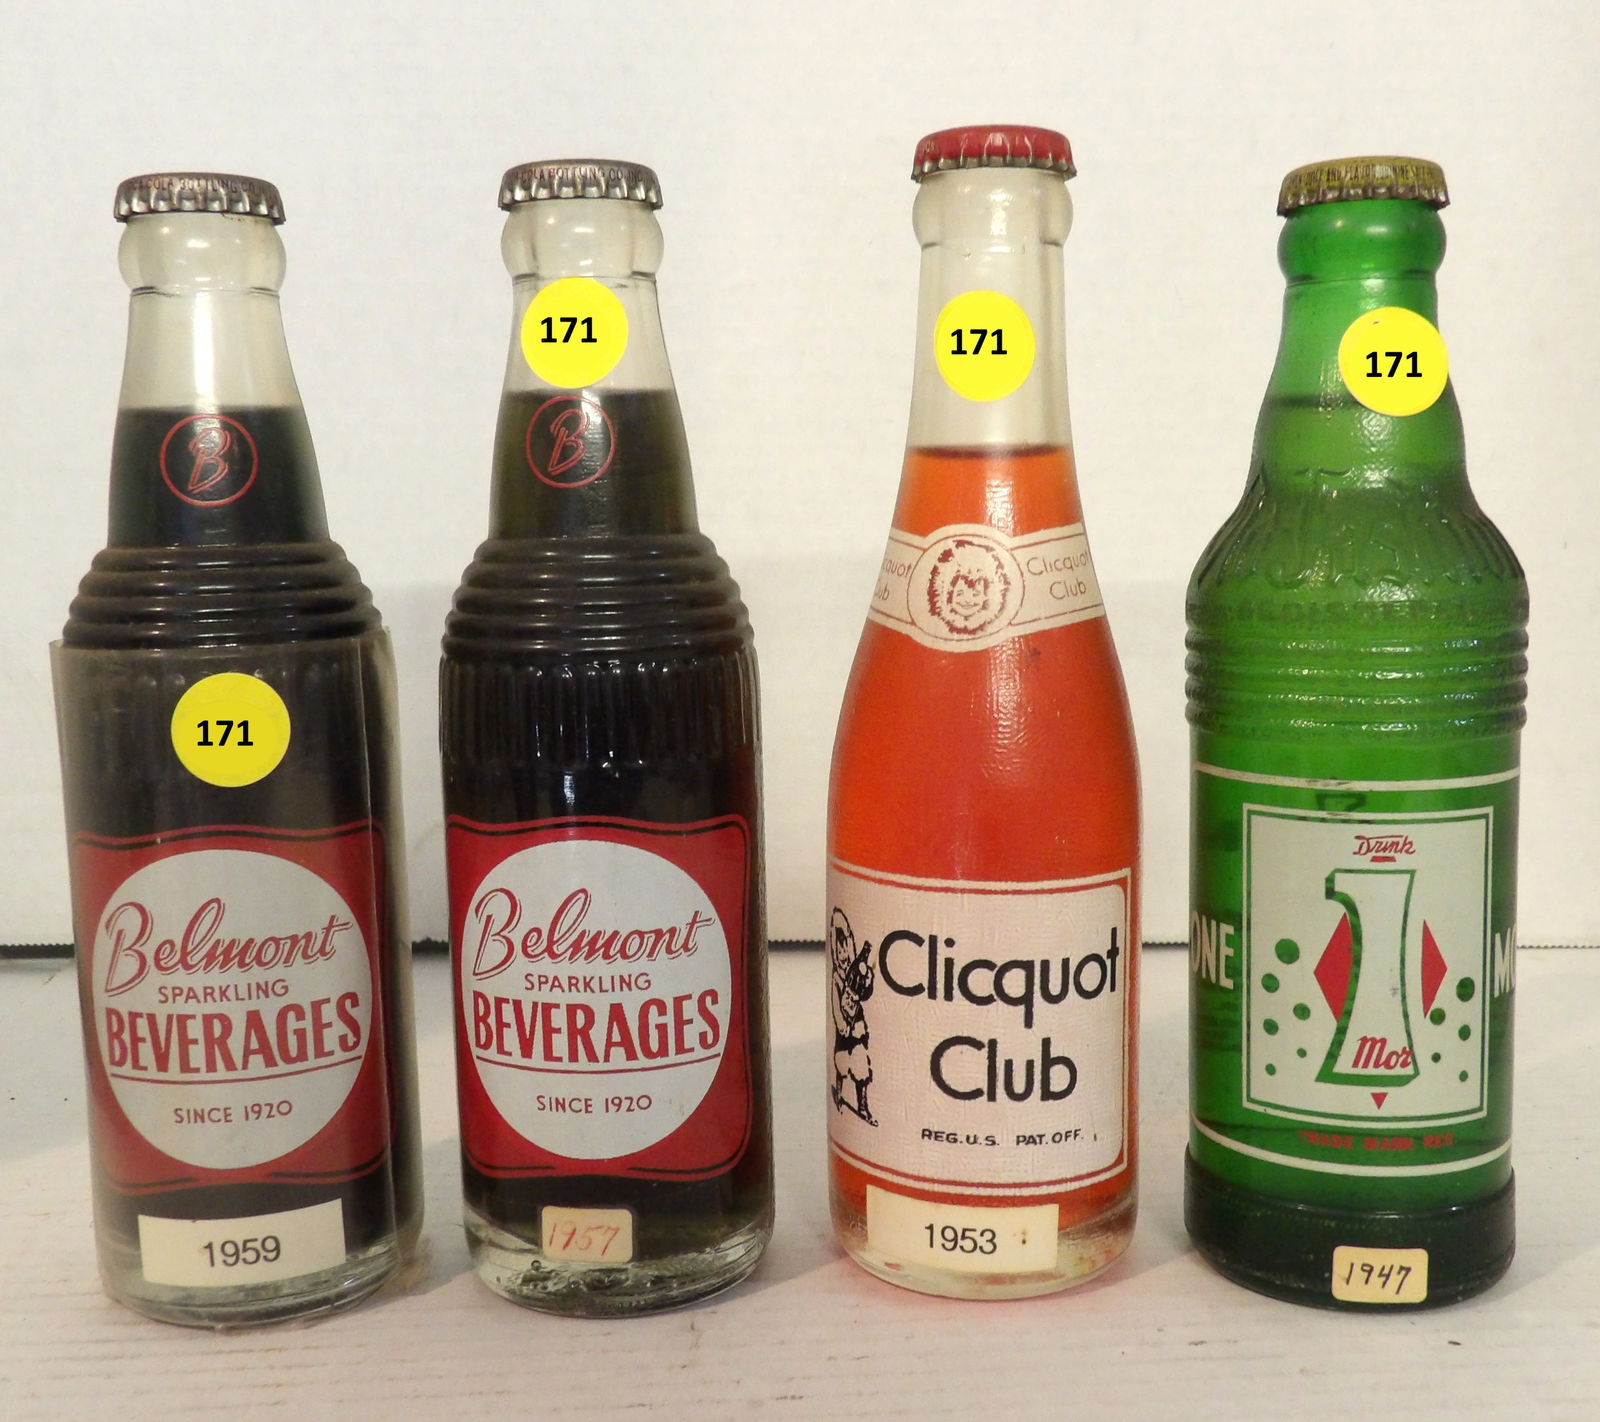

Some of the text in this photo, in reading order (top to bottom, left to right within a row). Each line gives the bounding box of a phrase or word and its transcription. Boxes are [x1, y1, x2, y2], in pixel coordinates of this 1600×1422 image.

[1048, 577, 1088, 600] Club
[1352, 835, 1417, 856] Drink
[105, 897, 354, 997] Belmont
[473, 887, 715, 981] Belmont
[1190, 910, 1235, 991] ONE
[157, 978, 290, 1005] SPARKLING
[524, 972, 652, 994] SPARKLING
[878, 926, 1120, 1030] Clicquot
[104, 991, 362, 1074] BEVERAGES
[472, 988, 721, 1064] BEVERAGES
[930, 1035, 1078, 1103] Club
[1351, 1035, 1415, 1071] Mor
[173, 1099, 293, 1125] SINCE 1920
[535, 1094, 653, 1114] SINCE 1920
[1298, 1129, 1354, 1151] TRADE
[1362, 1135, 1415, 1152] MARK
[202, 1235, 282, 1268] 1959
[548, 1221, 621, 1257] 1957
[924, 1223, 998, 1255] 1953
[1345, 1261, 1412, 1296] 1947
